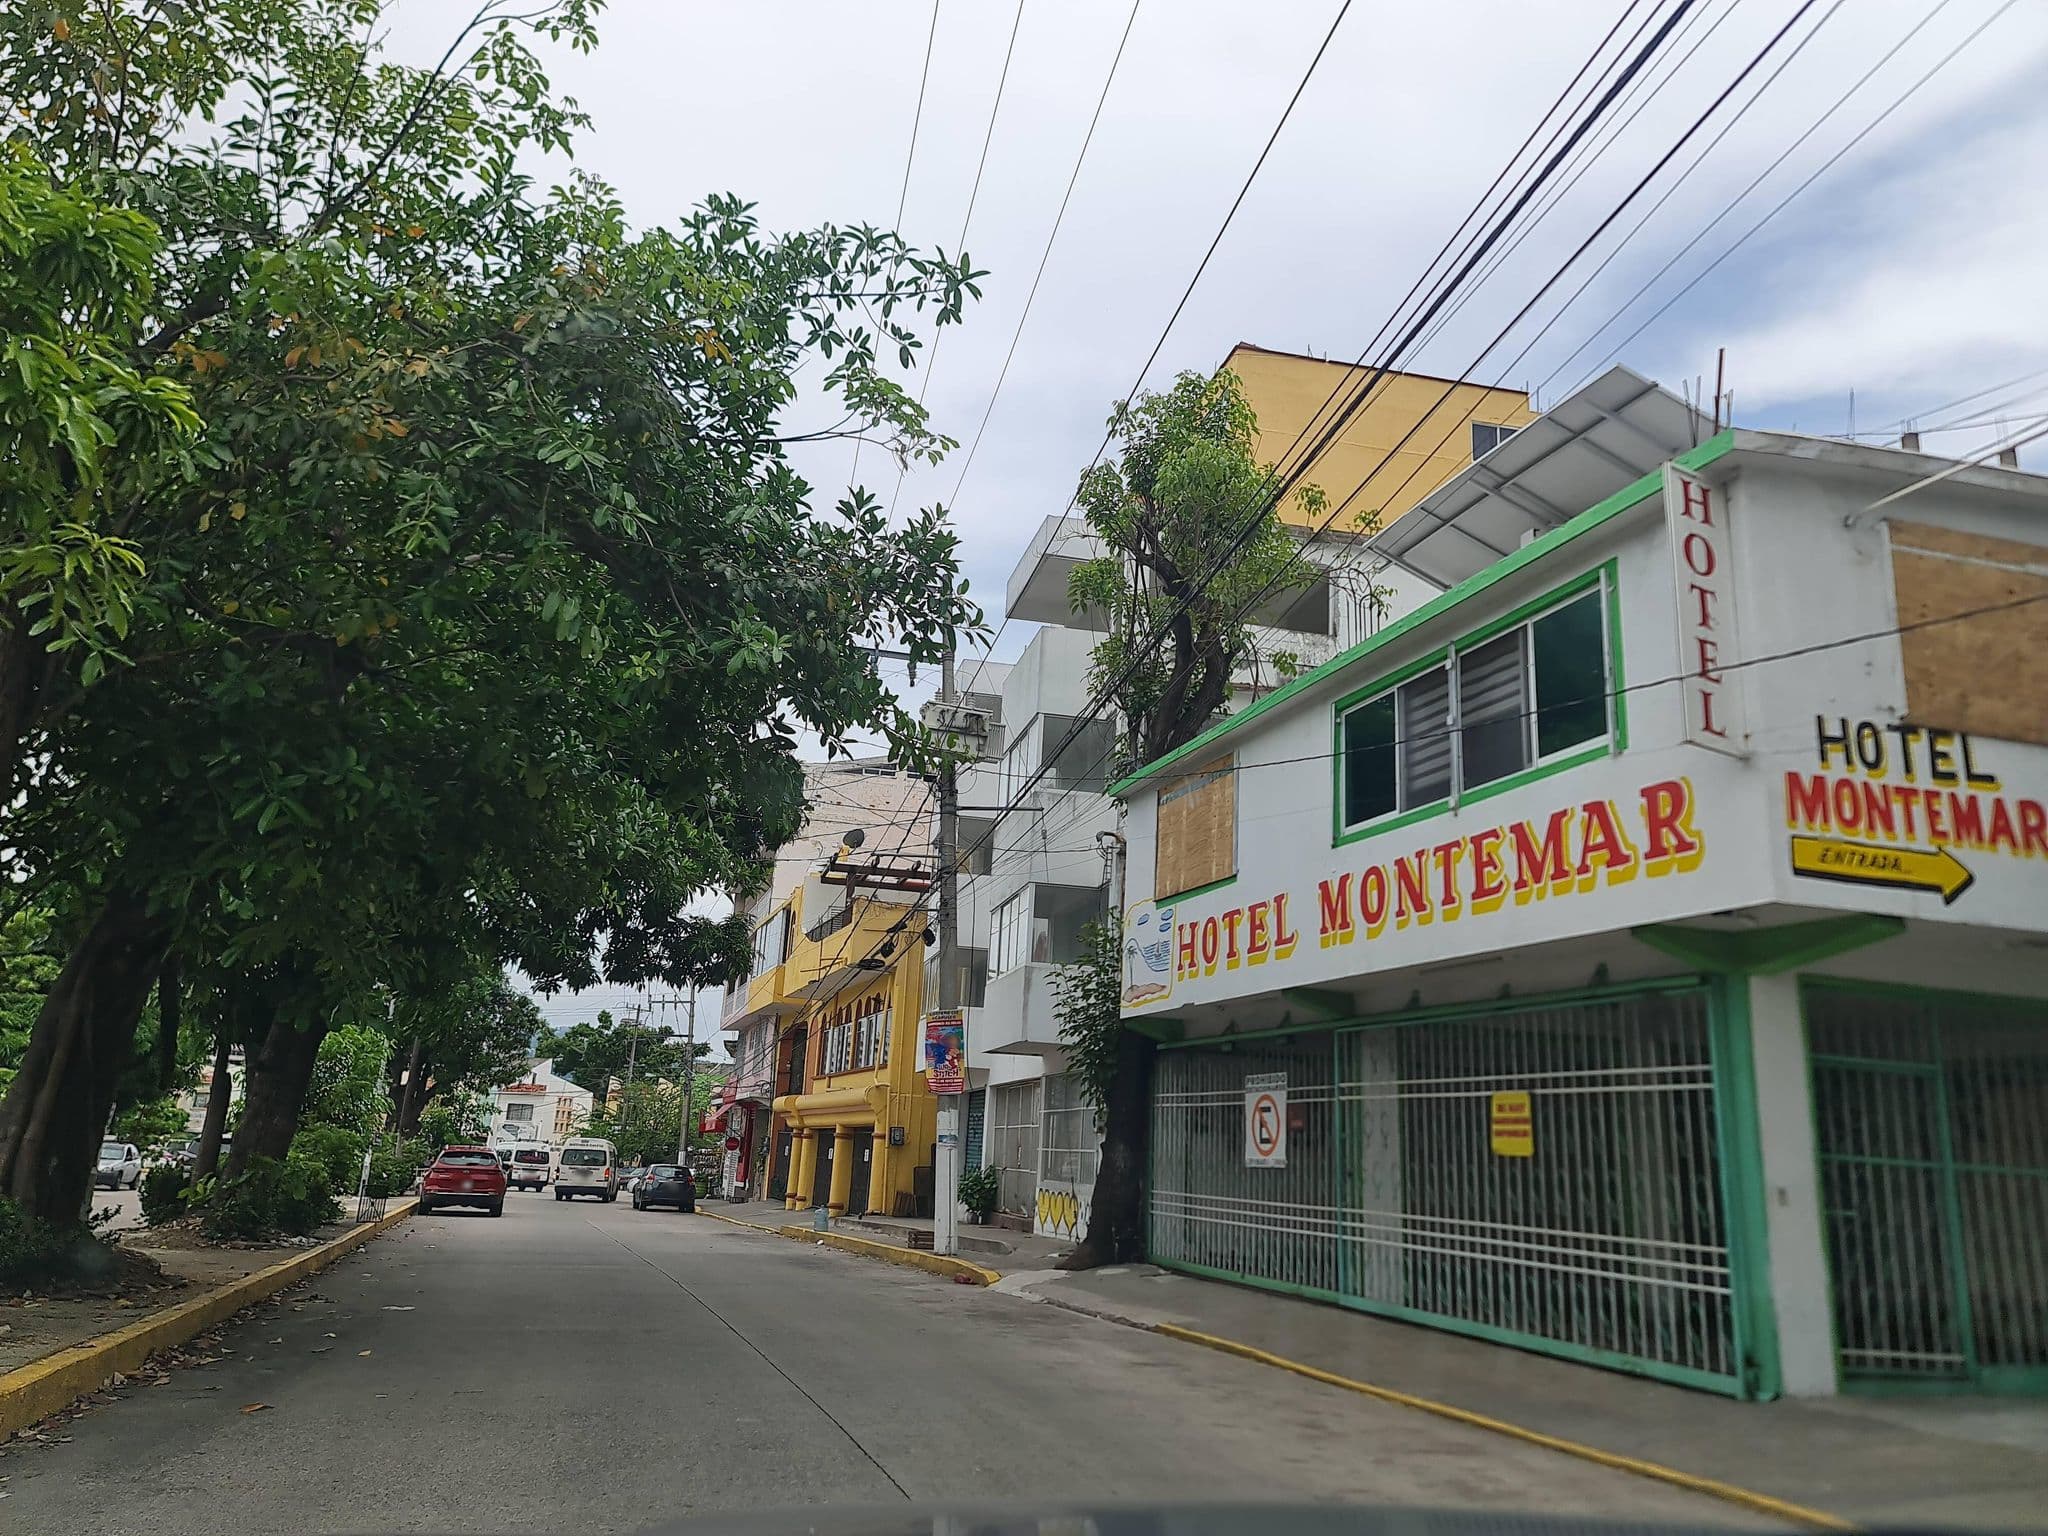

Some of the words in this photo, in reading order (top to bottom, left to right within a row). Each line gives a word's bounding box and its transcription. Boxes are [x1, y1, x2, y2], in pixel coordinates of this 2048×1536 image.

[1681, 478, 1728, 738] HOTEL
[1785, 771, 2048, 857] MONTEMAR
[1815, 714, 2001, 789] HOTEL
[1177, 892, 1297, 981] HOTEL
[1318, 777, 1704, 947] MONTEMAR
